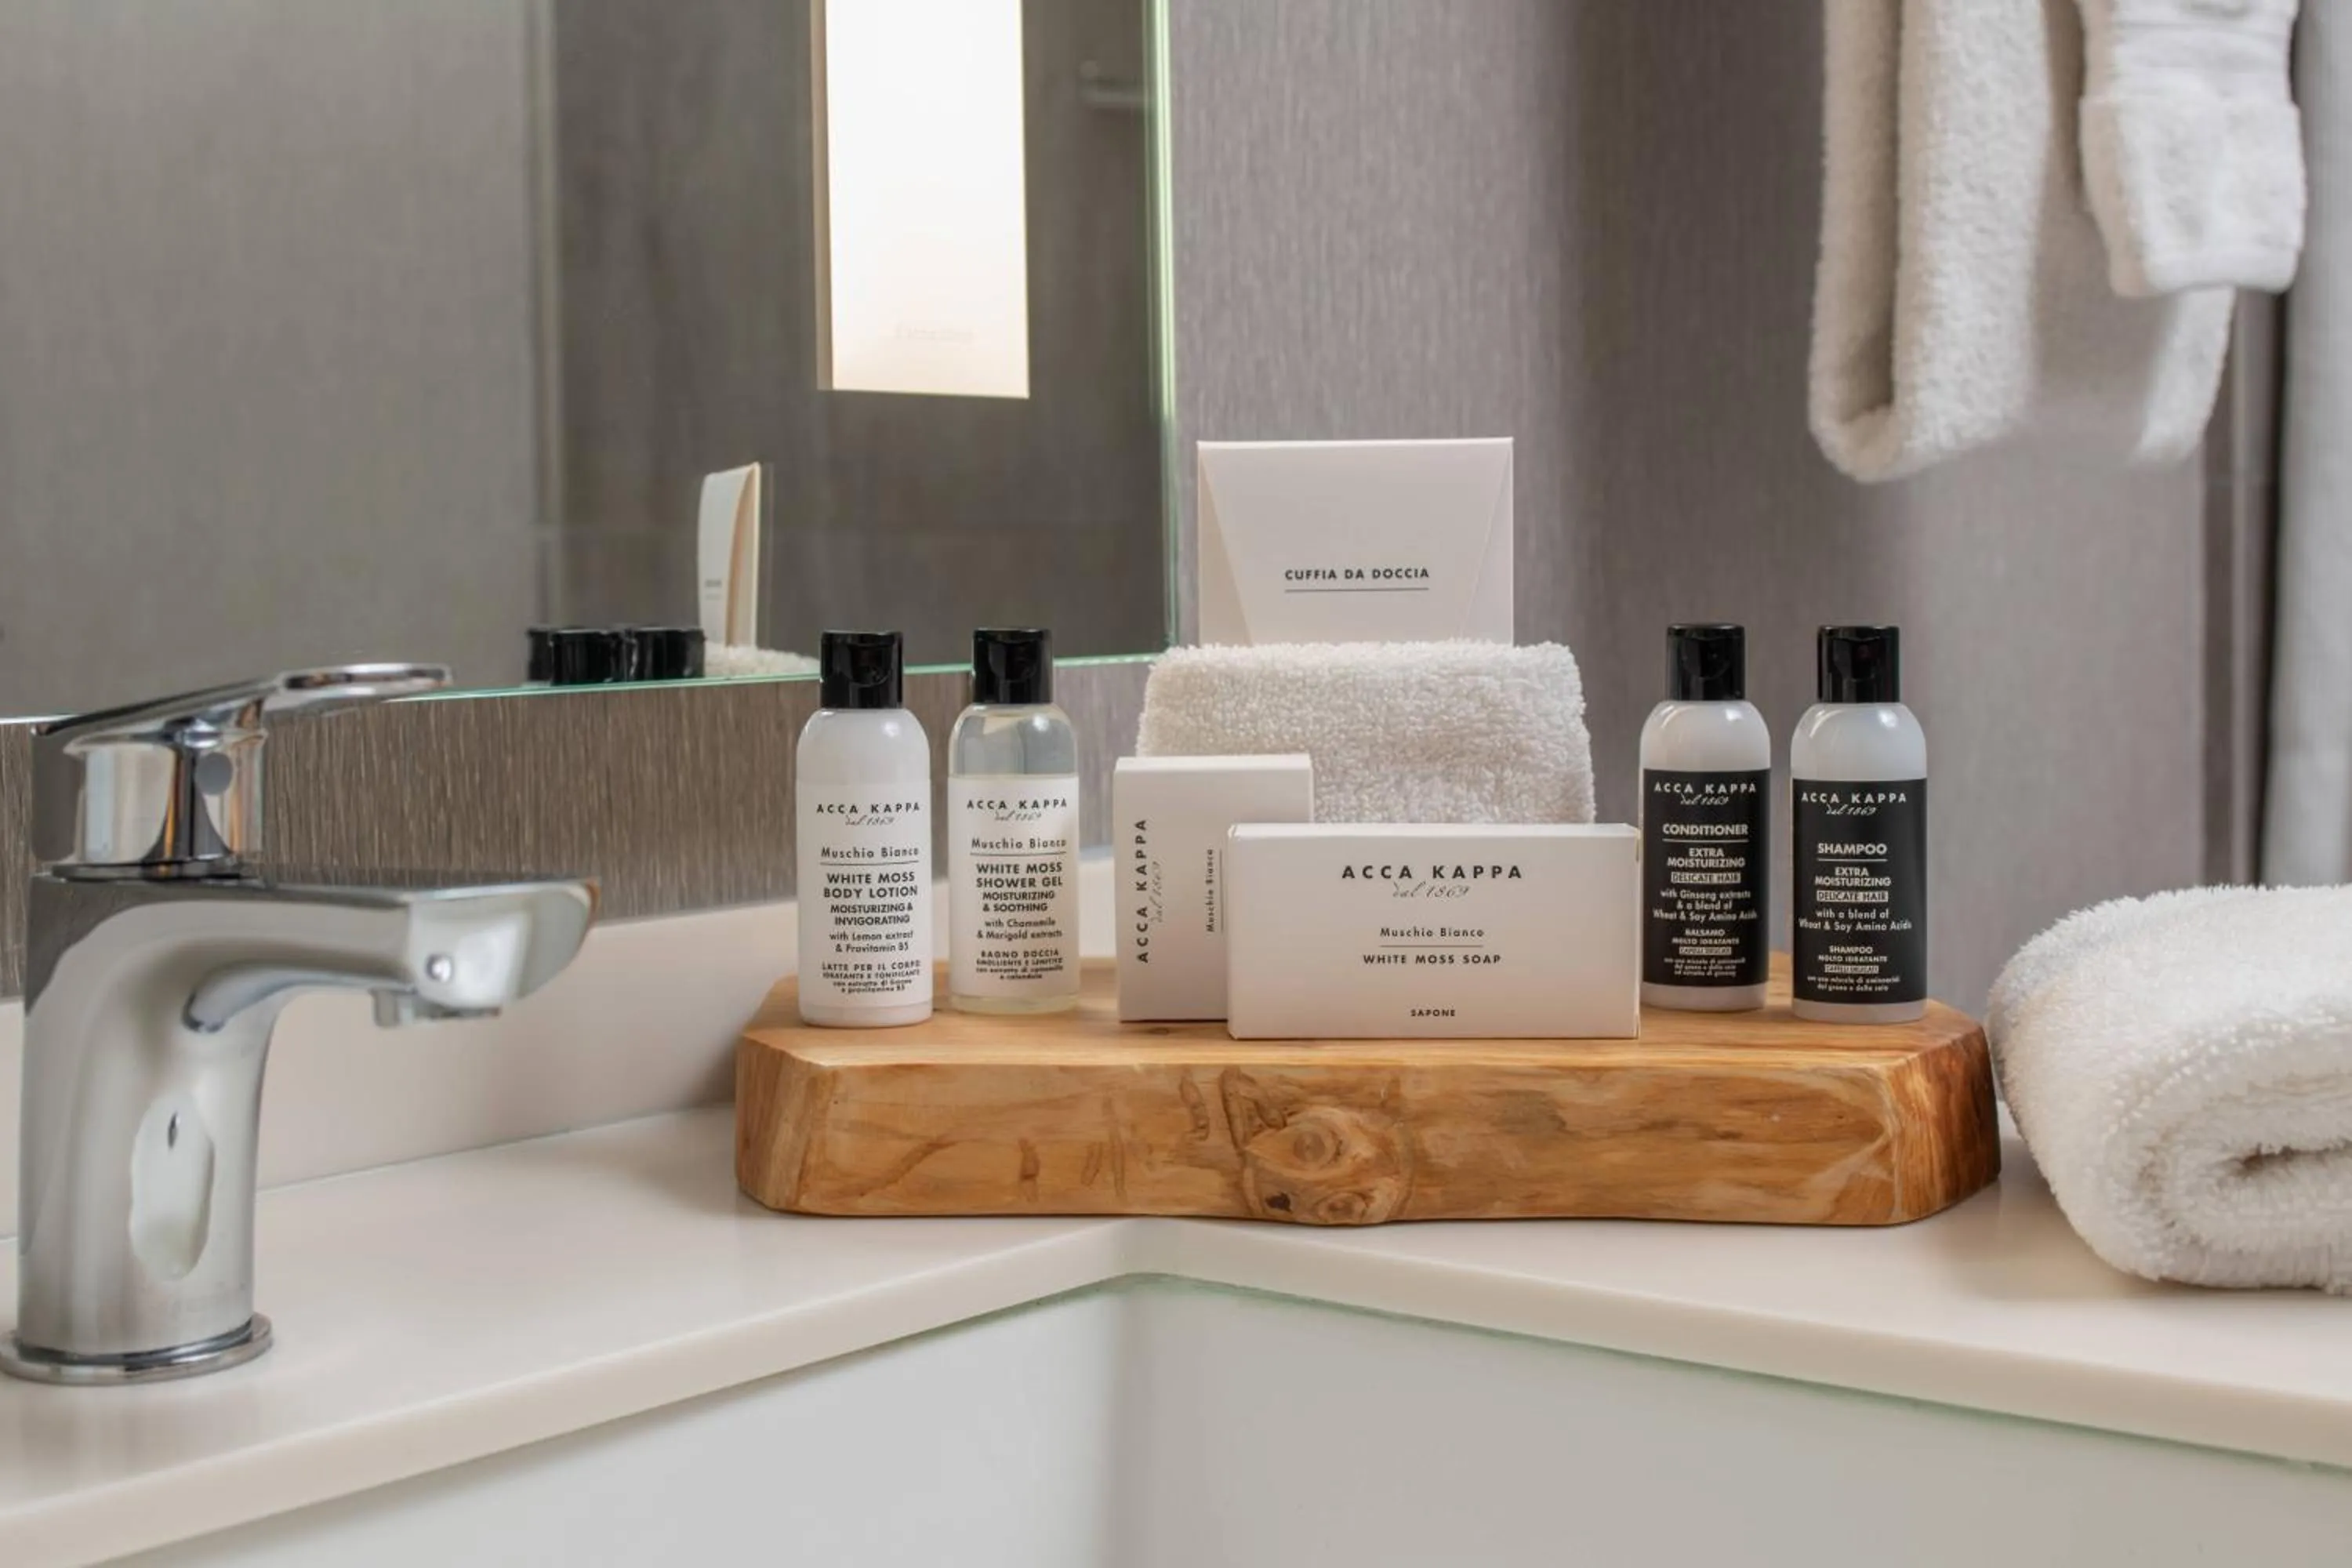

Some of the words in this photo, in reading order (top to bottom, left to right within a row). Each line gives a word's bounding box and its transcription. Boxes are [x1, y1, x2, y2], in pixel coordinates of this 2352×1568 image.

[1285, 569, 1338, 580] CUFFIA
[1345, 569, 1364, 579] DA
[1372, 568, 1429, 579] DOCCIA
[1654, 782, 1693, 793] ACCA
[1705, 783, 1756, 793] KAPPA
[1801, 792, 1839, 804] ACCA
[1851, 793, 1907, 804] KAPPA
[816, 804, 858, 814] ACCA
[871, 802, 920, 813] KAPPA
[967, 800, 1007, 810] ACCA
[1018, 798, 1067, 809] KAPPA
[1826, 804, 1849, 815] dal
[1847, 806, 1876, 815] 1869
[1662, 823, 1748, 836] CONDITIONER
[971, 837, 1023, 849] Muschio
[1029, 837, 1066, 848] Bianco
[821, 846, 875, 858] Muschio
[880, 847, 919, 857] Bianco
[1689, 848, 1725, 857] EXTRA
[1817, 843, 1887, 855] SHAMPOO
[1134, 820, 1147, 891] KAPPA
[976, 863, 1020, 874] WHITE
[1026, 862, 1062, 873] MOSS
[1205, 849, 1214, 884] Bianco
[1667, 857, 1746, 868] MOISTURIZING
[1341, 865, 1413, 880] ACCA
[1432, 865, 1522, 880] KAPPA
[1835, 867, 1869, 877] EXTRA
[826, 873, 872, 884] WHITE
[877, 872, 915, 883] MOSS
[976, 877, 1036, 887] SHOWER
[1042, 877, 1063, 887] GEL
[1815, 877, 1892, 886] MOISTURIZING
[823, 888, 862, 898] BODY
[869, 887, 917, 898] LOTION
[1392, 881, 1426, 898] dal
[1425, 884, 1470, 898] 1869
[1661, 887, 1677, 898] with
[982, 891, 1055, 901] MOISTURIZING
[1818, 891, 1860, 900] DELICATE
[830, 903, 906, 913] MOISTURIZING
[906, 902, 913, 911] &
[993, 903, 1048, 912] SOOTHING
[1205, 889, 1214, 932] Muschio
[1695, 900, 1721, 910] blend
[1690, 911, 1706, 923] Soy
[1816, 909, 1835, 918] with
[1848, 909, 1875, 919] blend
[1879, 909, 1889, 919] of
[835, 915, 910, 926] INVIGORATING
[985, 919, 1004, 927] with
[1007, 917, 1056, 927] Chamomile
[1380, 926, 1433, 938] Muschio
[1440, 927, 1484, 938] Bianco
[1824, 921, 1831, 930] &
[1835, 922, 1852, 933] Soy
[1855, 922, 1887, 931] Amino
[829, 931, 848, 940] with
[852, 932, 882, 941] Lemon
[886, 931, 913, 940] extract
[986, 931, 1027, 941] Marigold
[1031, 930, 1062, 938] extracts
[1137, 906, 1149, 964] ACCA
[835, 944, 843, 953] &
[846, 942, 895, 953] Provitamin
[898, 942, 909, 951] B5
[1828, 945, 1873, 953] SHAMPOO
[1363, 954, 1407, 964] WHITE
[1415, 954, 1455, 964] MOSS
[1462, 954, 1501, 964] SOAP
[822, 962, 848, 971] LATTE
